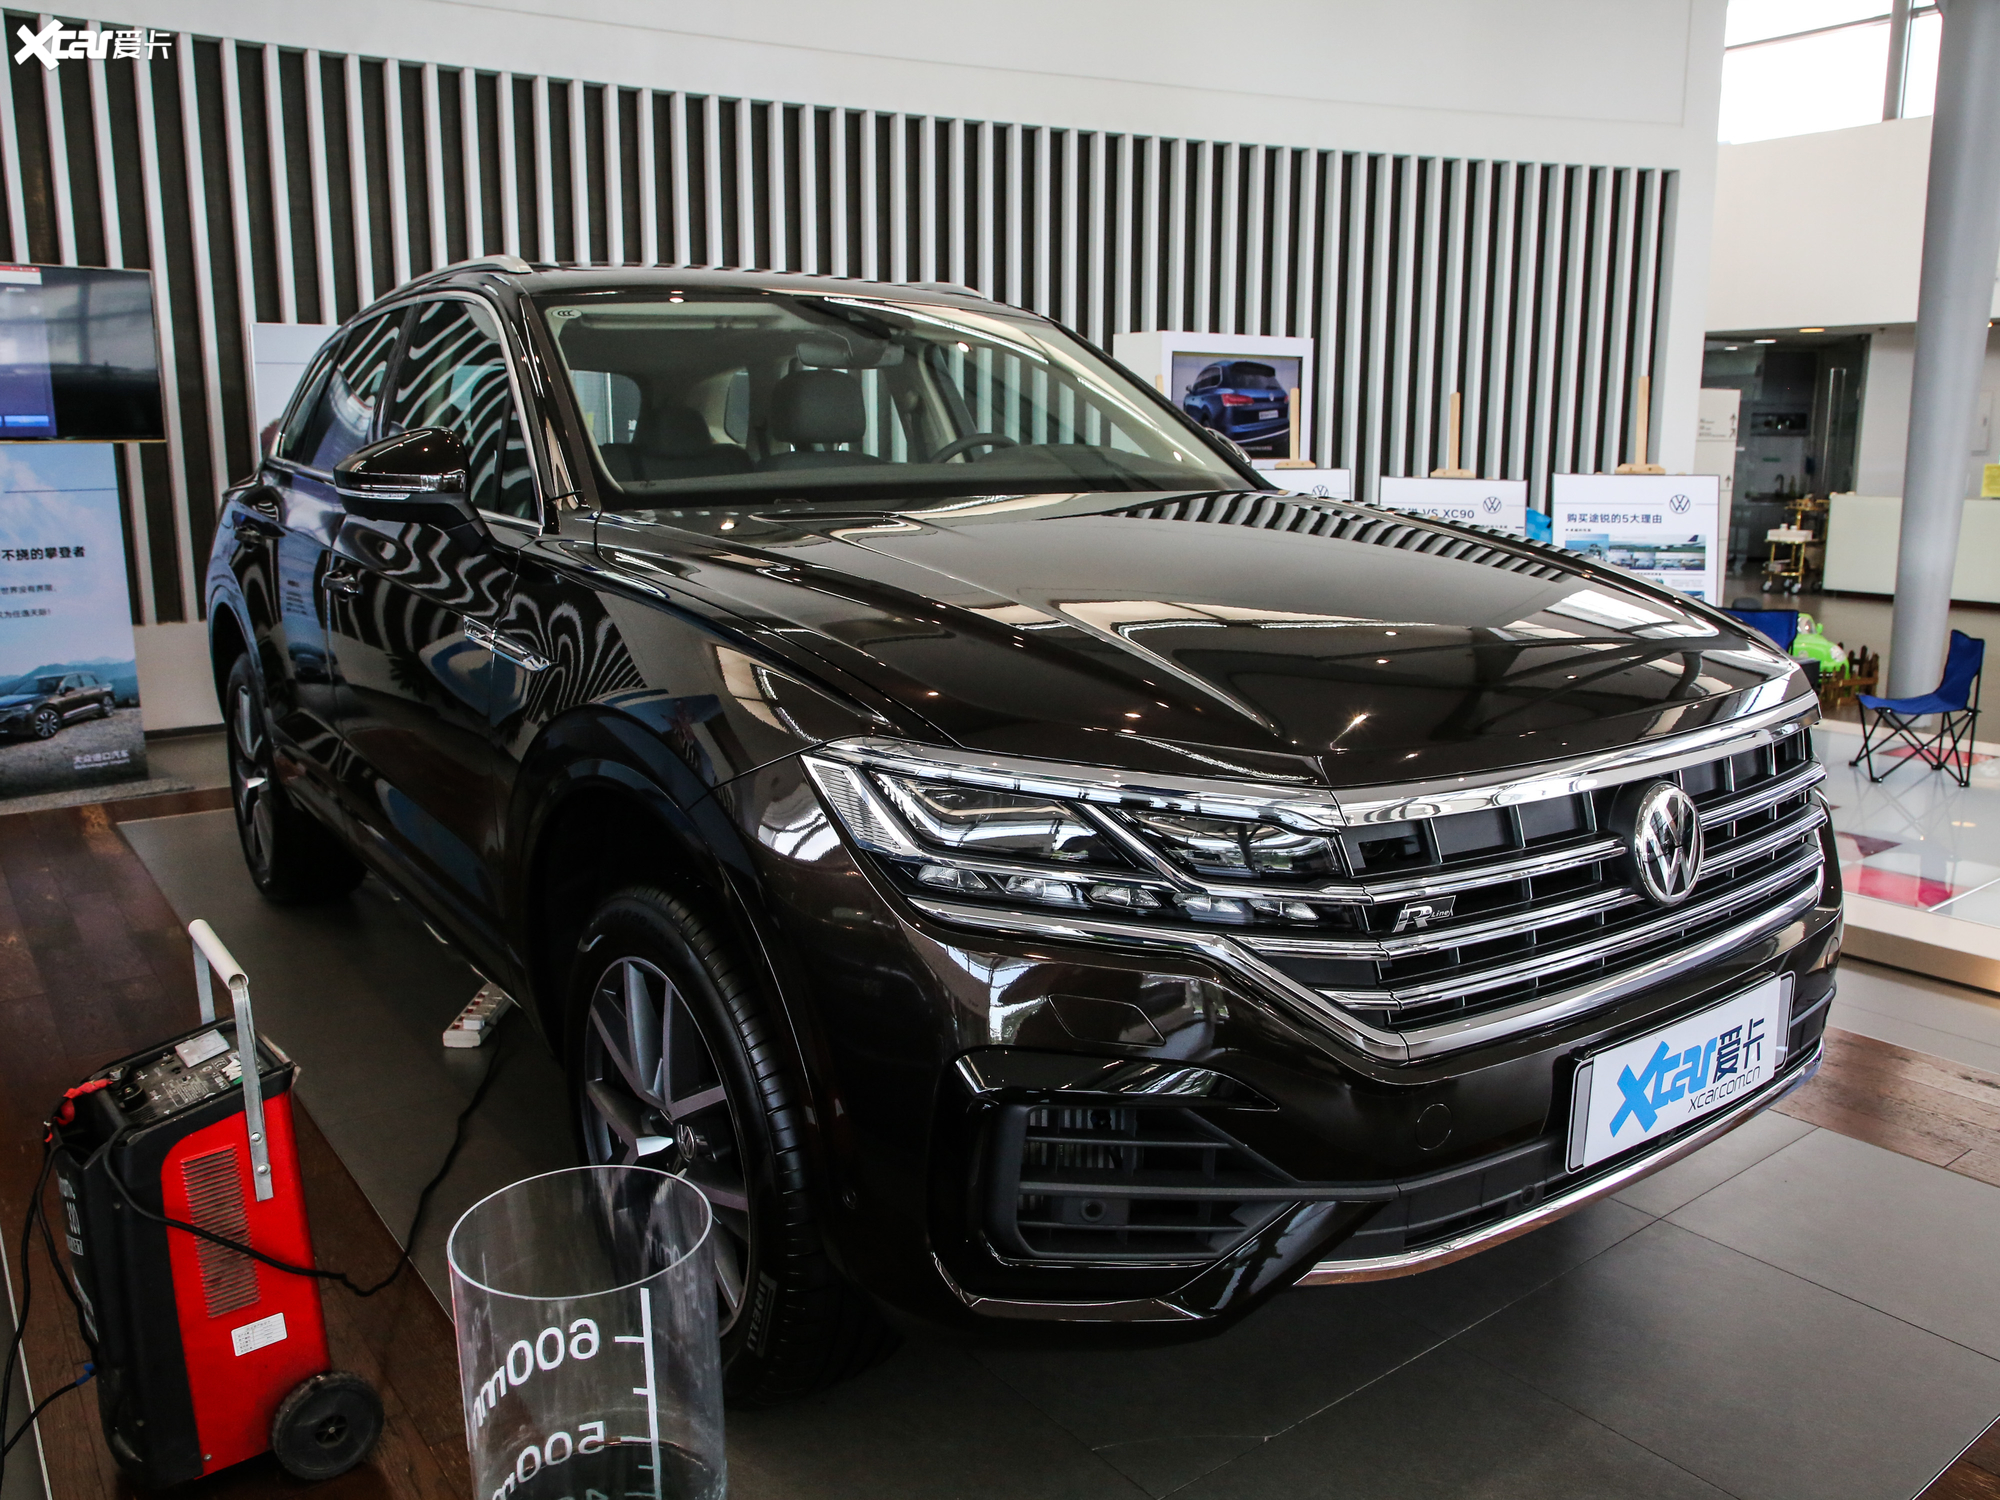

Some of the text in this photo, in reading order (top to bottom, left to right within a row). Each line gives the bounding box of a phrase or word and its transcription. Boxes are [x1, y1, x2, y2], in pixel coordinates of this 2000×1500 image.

[1443, 508, 1475, 519] XC90
[1567, 513, 1663, 524] 购买途锐的5大理由
[1712, 1017, 1765, 1084] 爱卡
